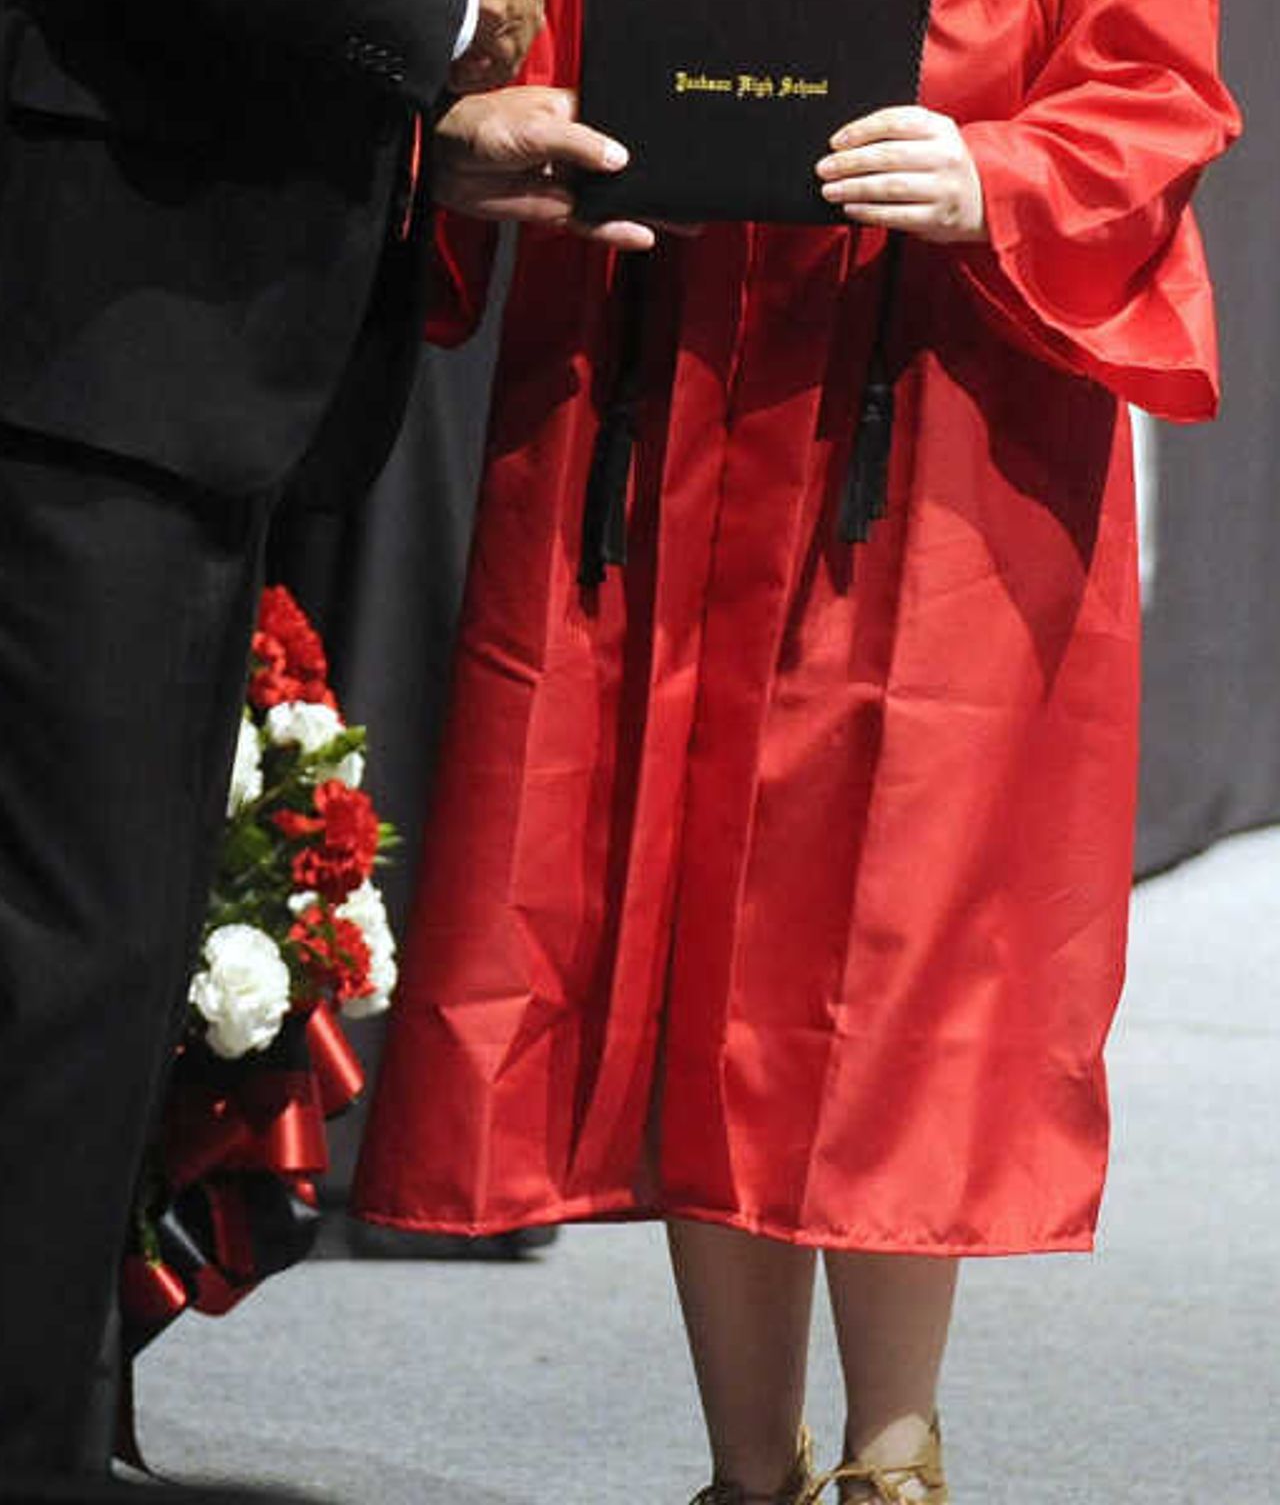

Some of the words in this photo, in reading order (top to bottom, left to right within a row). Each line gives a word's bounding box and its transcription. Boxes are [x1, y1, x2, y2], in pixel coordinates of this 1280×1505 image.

[675, 72, 732, 92] Jackson
[736, 74, 773, 98] High
[778, 77, 828, 98] School
